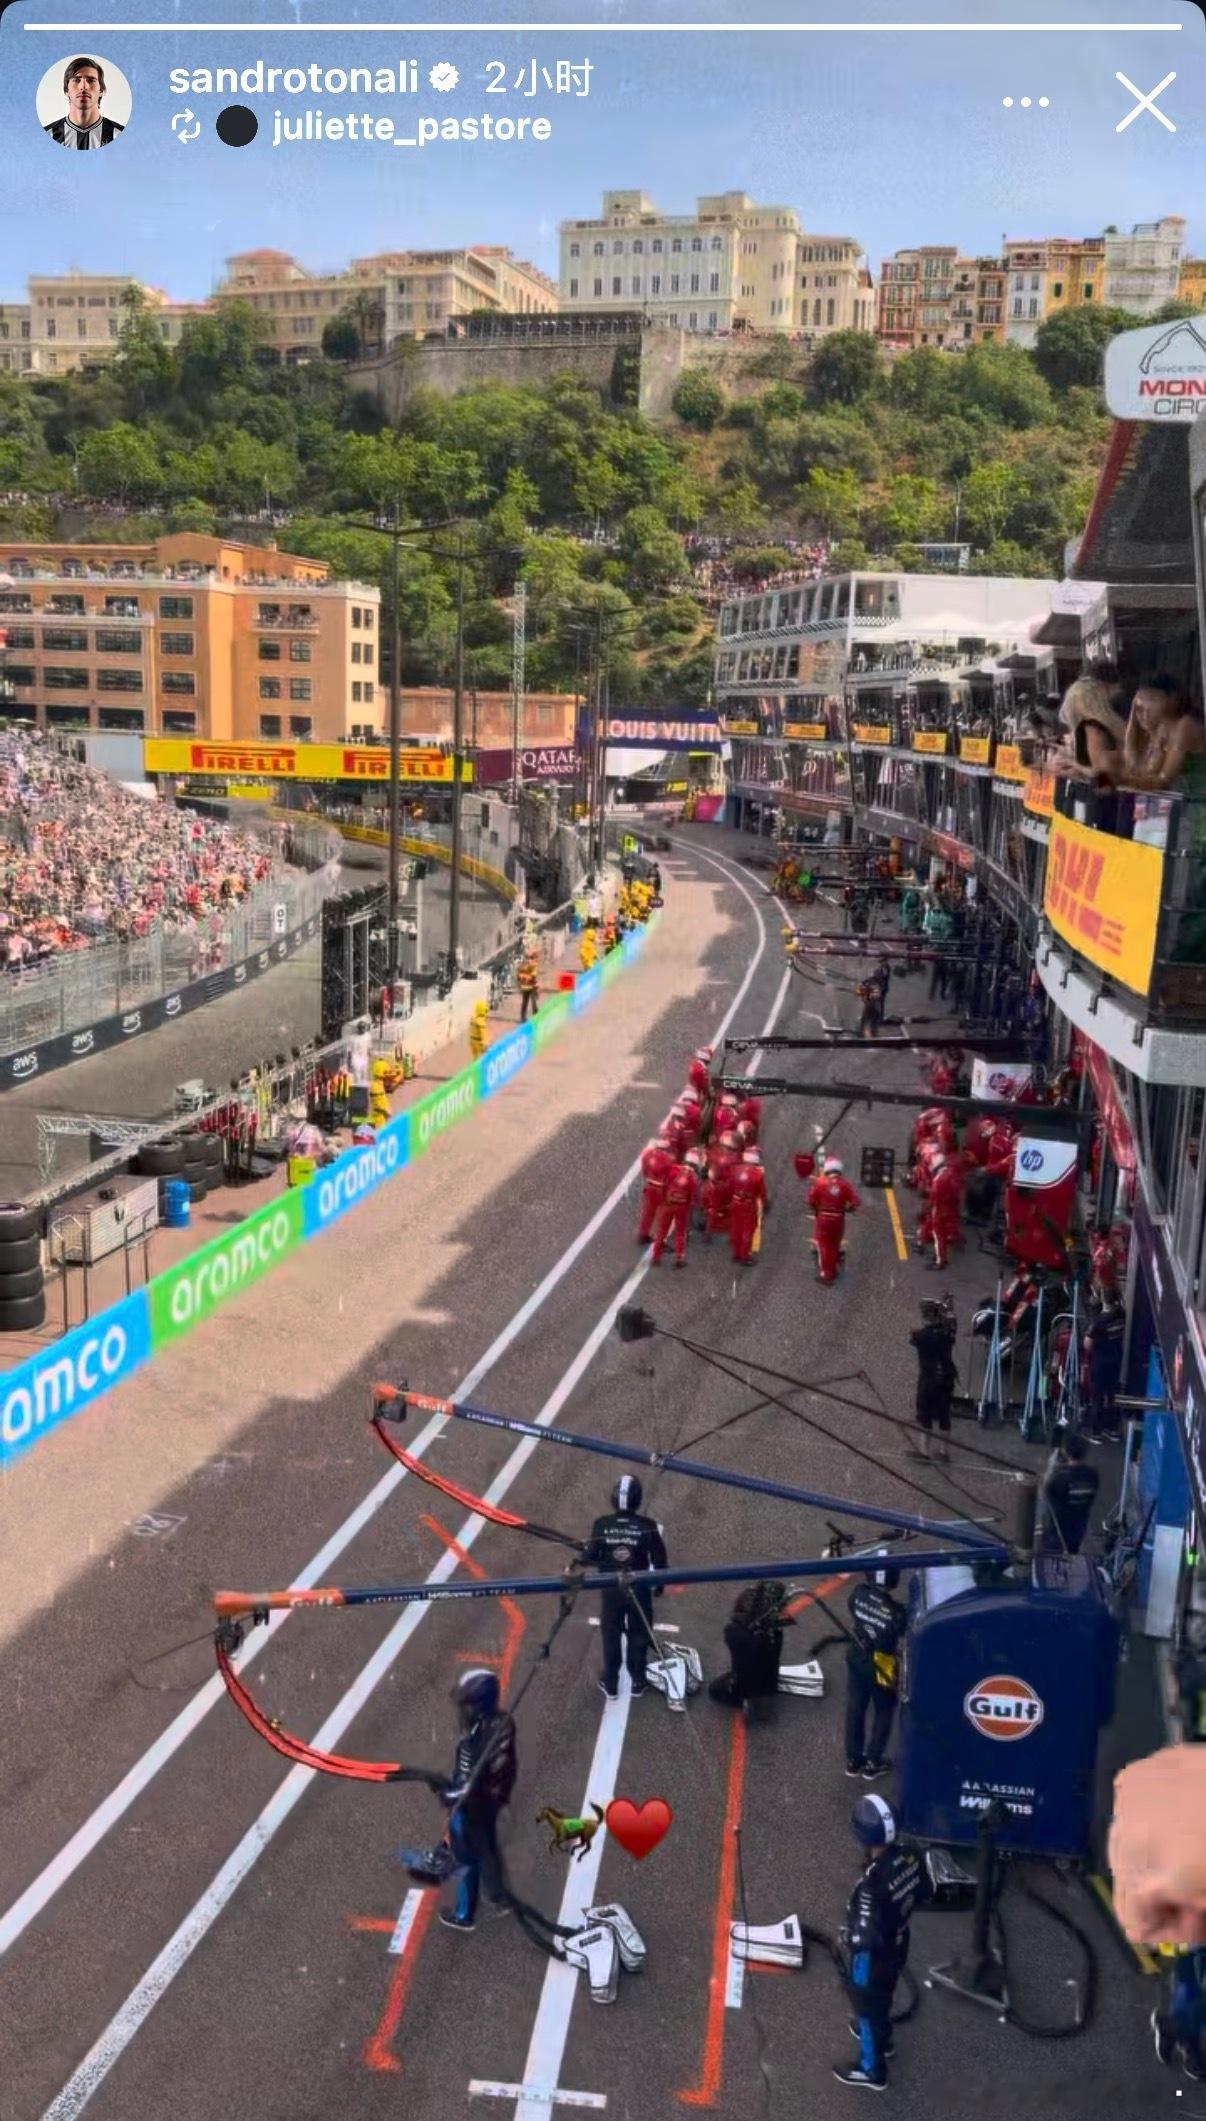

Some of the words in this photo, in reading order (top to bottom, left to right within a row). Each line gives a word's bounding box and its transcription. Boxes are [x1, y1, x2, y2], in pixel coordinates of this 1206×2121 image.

[662, 721, 721, 742] VUITT
[191, 745, 295, 772] PIRELLI
[12, 1051, 38, 1071] aws
[319, 1136, 399, 1216] aramco
[171, 1211, 290, 1323] aramco
[969, 1696, 1039, 1721] Gulf
